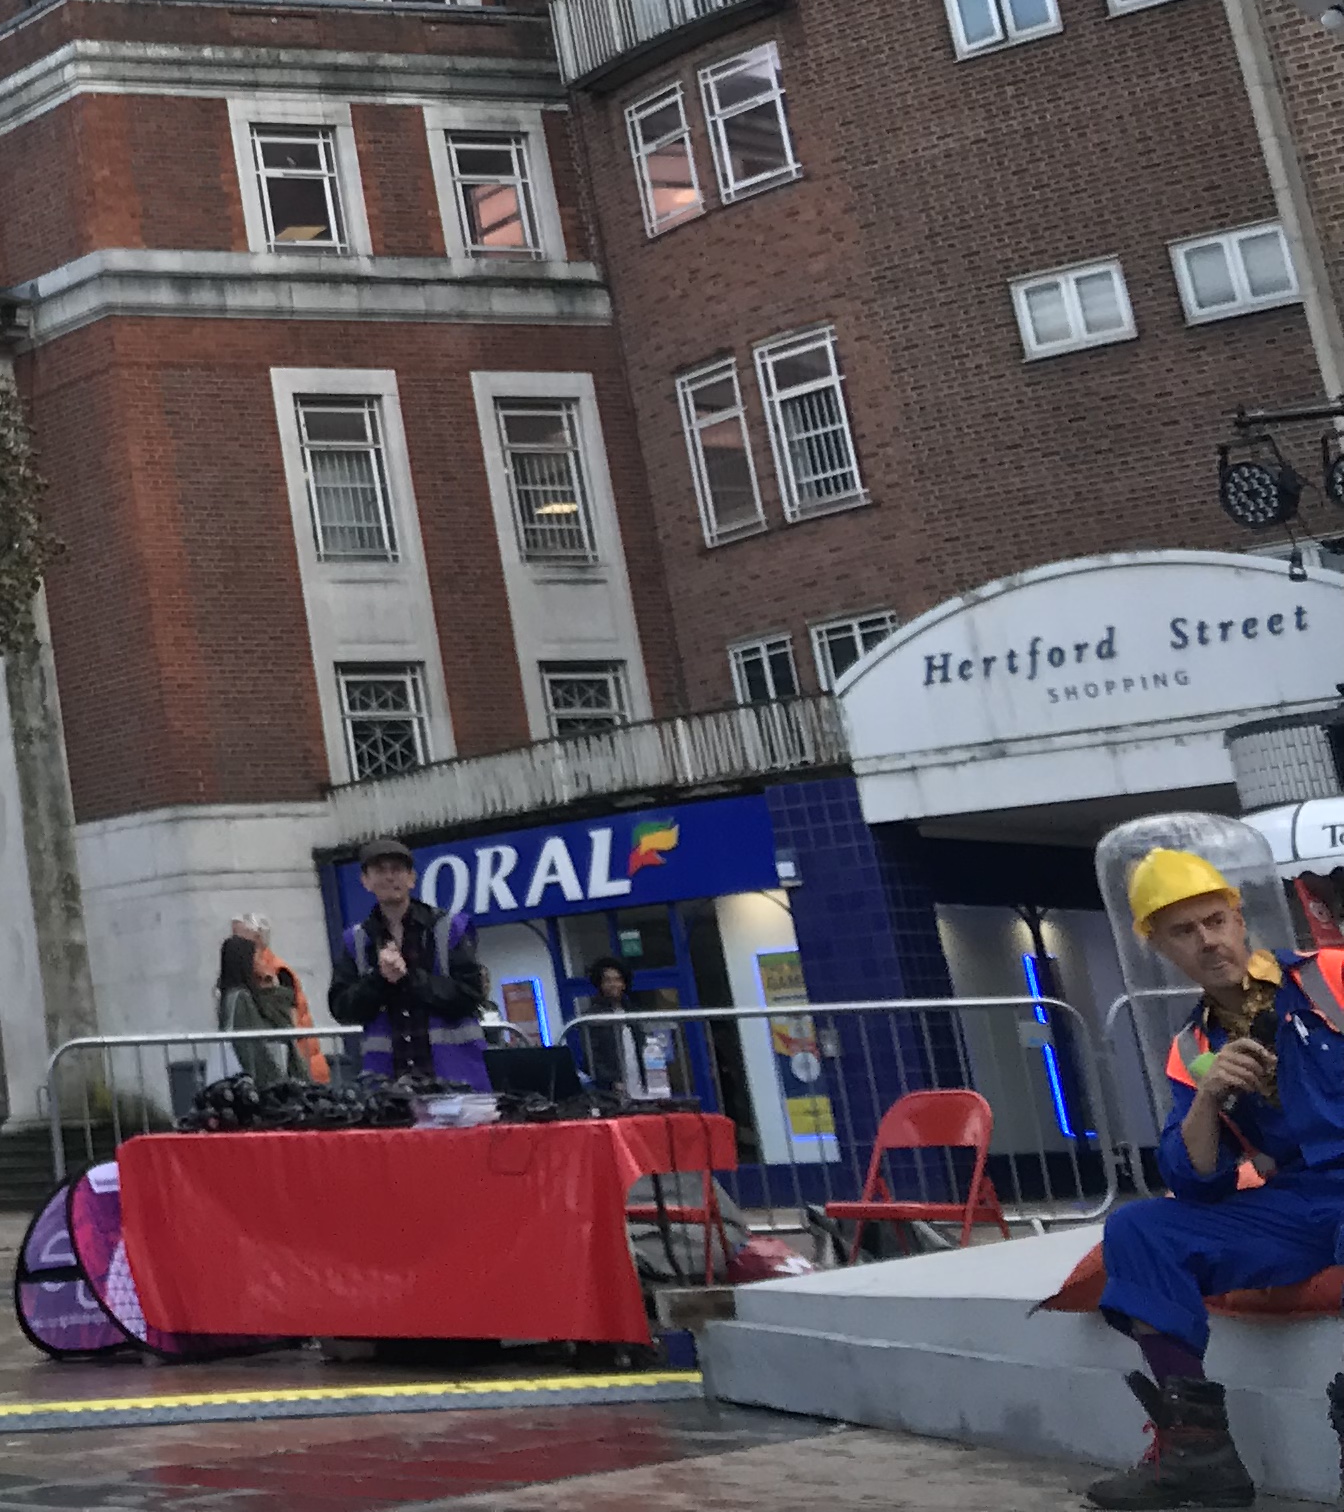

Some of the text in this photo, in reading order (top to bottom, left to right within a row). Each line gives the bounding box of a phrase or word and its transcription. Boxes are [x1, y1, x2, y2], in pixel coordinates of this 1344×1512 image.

[922, 604, 1309, 687] Hertford Street
[1048, 669, 1192, 704] SHOPPING
[420, 827, 632, 916] ORAL
